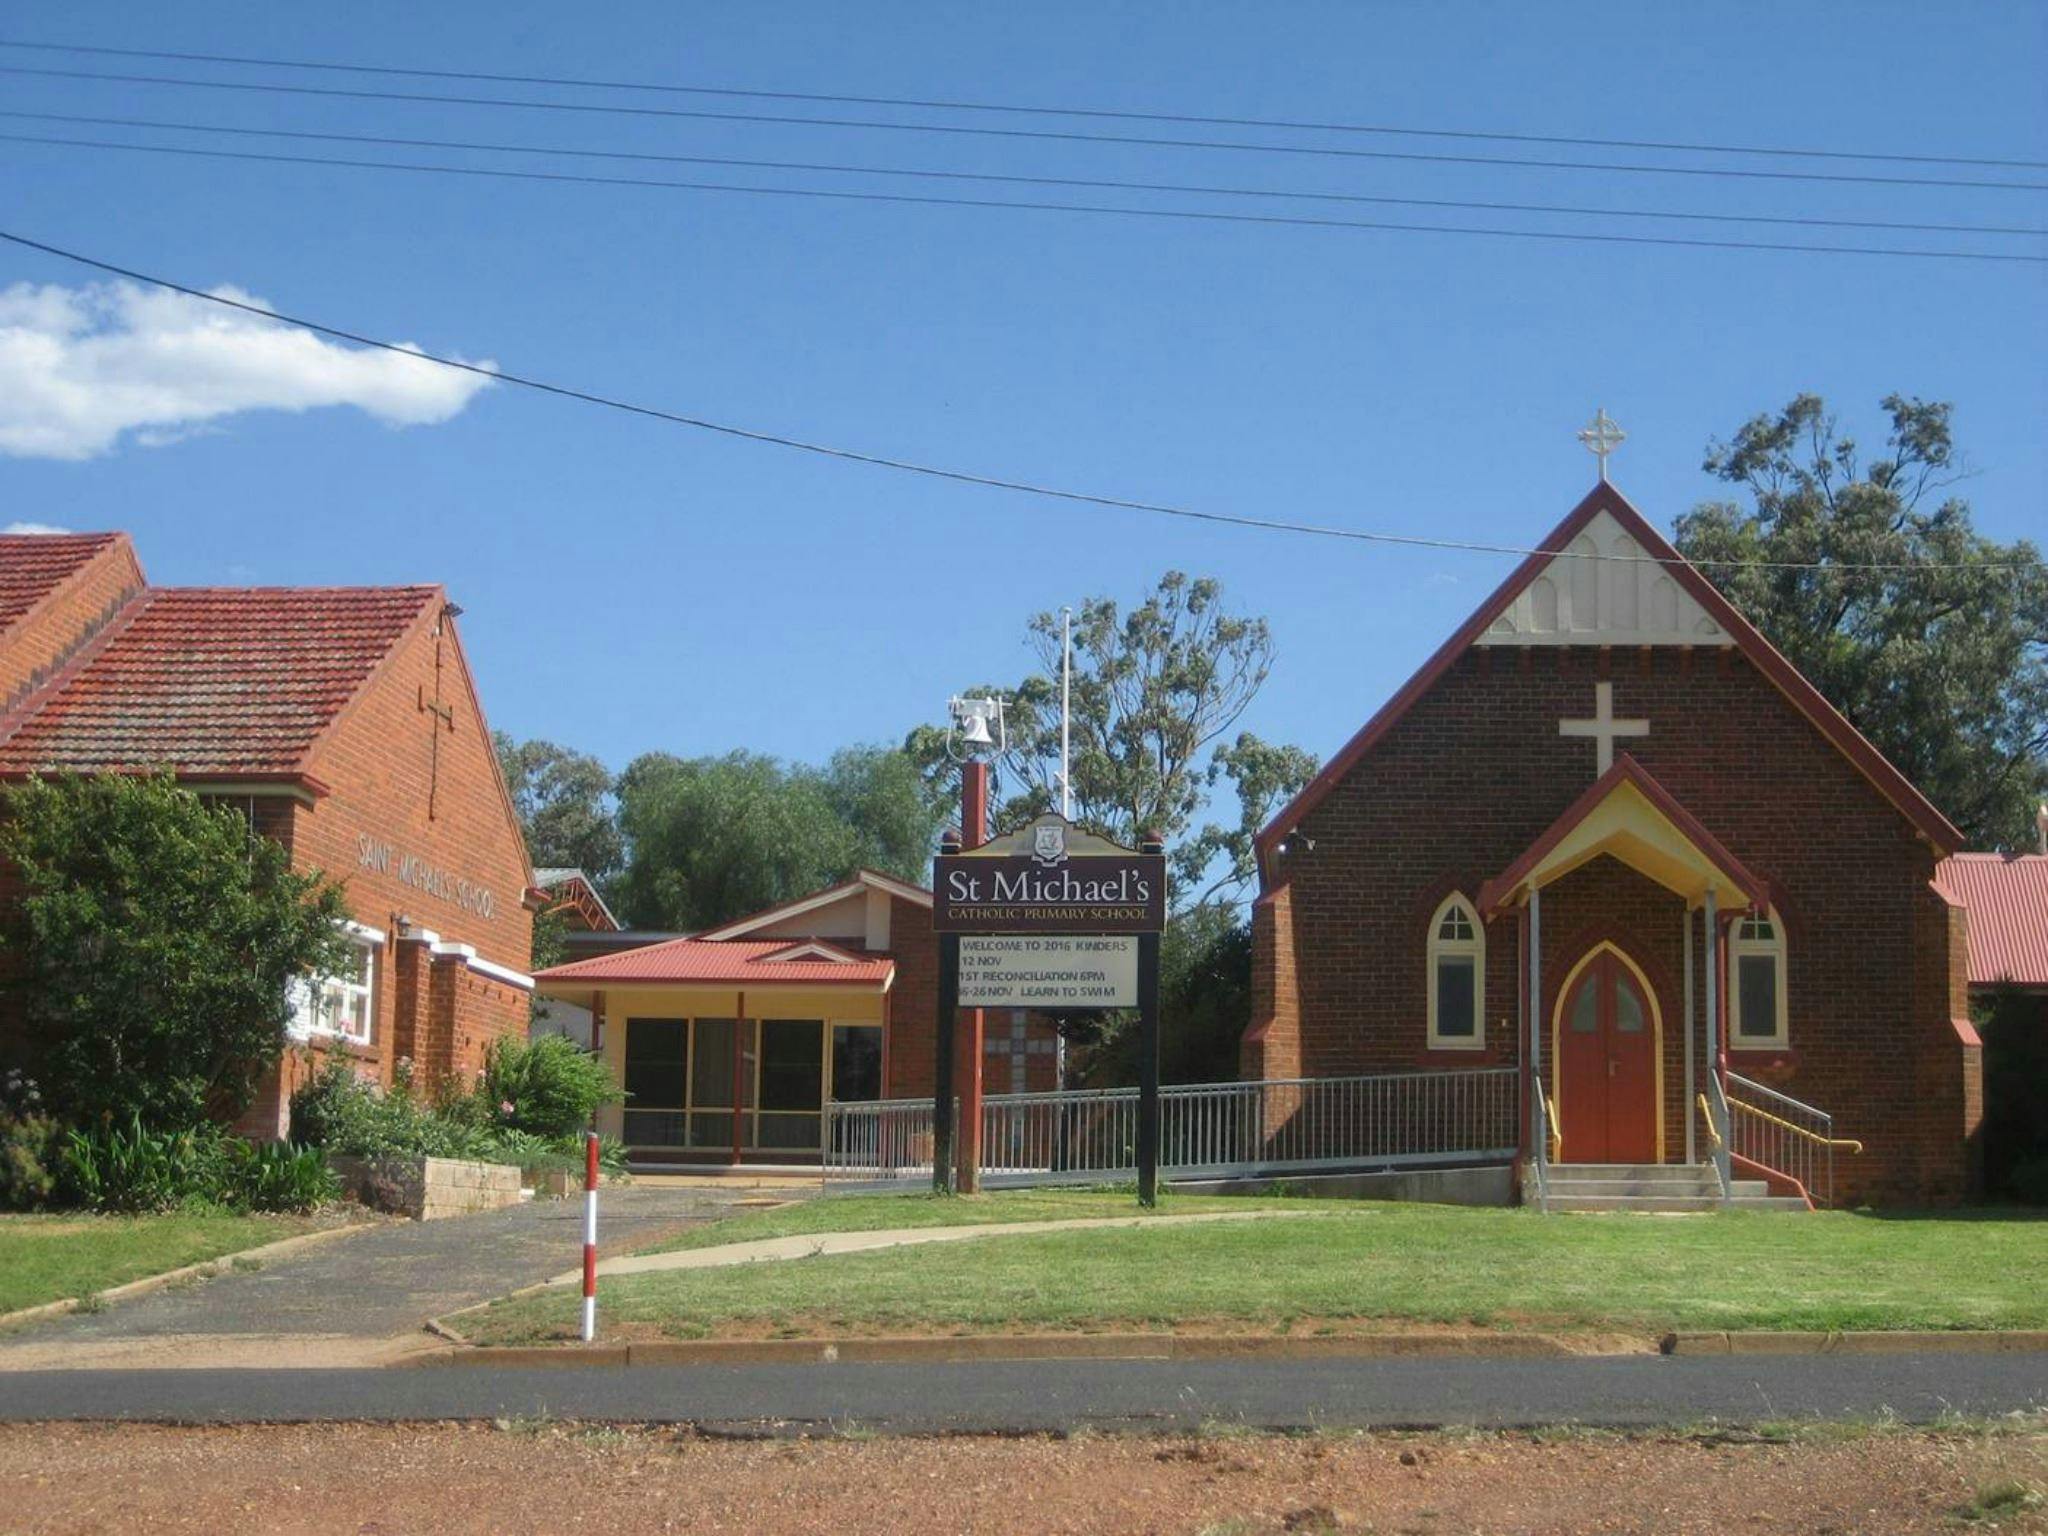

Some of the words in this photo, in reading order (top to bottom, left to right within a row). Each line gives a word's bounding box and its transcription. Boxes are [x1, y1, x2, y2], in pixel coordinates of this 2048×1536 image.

[949, 871, 981, 901] St
[991, 869, 1149, 901] Michael's
[949, 908, 1021, 919] CATHOLIC
[1025, 908, 1087, 919] PRIMARY
[1091, 908, 1147, 919] SCHOOL
[962, 940, 1022, 951] WELCOME
[1025, 940, 1040, 950] TO
[1044, 941, 1071, 951] 2016
[1075, 941, 1128, 952] KINDERS
[961, 956, 974, 966] 12
[978, 956, 1002, 966] NOV
[960, 971, 979, 981] 1ST
[987, 986, 1013, 996] NOV
[1020, 986, 1059, 997] LEARN
[1062, 986, 1077, 997] TO
[1080, 986, 1116, 997] SWIM
